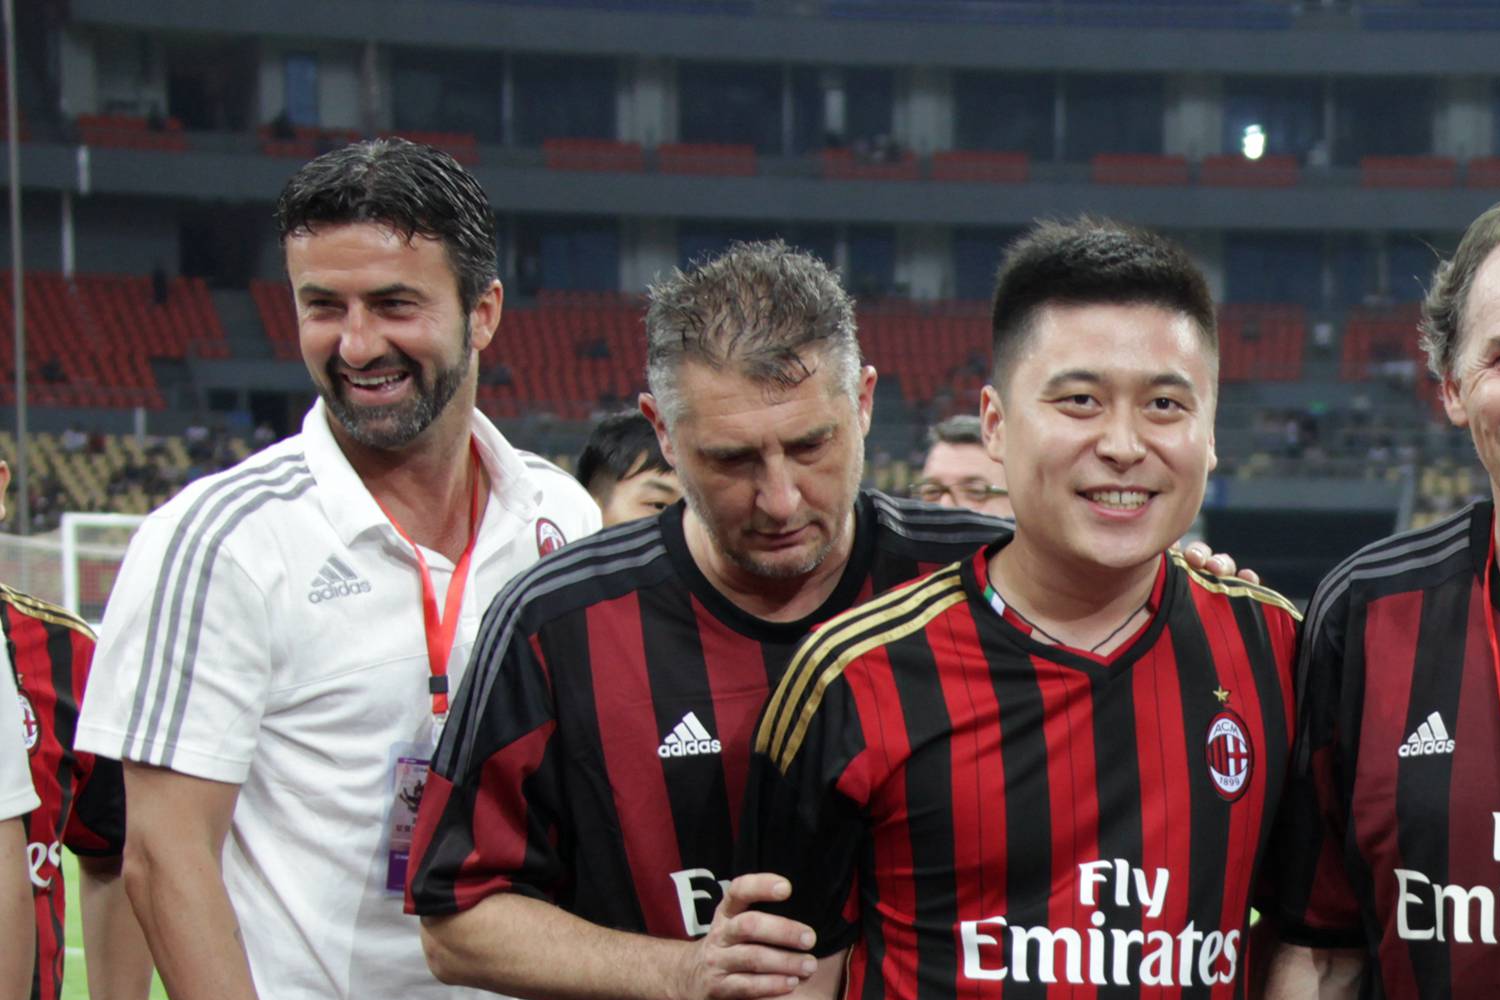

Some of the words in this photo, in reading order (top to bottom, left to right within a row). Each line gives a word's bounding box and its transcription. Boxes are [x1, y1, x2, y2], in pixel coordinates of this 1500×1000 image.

[308, 579, 371, 604] adidas
[657, 738, 722, 758] adidas
[1397, 738, 1456, 758] adidas
[1078, 858, 1170, 918] Fly
[959, 910, 1241, 987] Emirates
